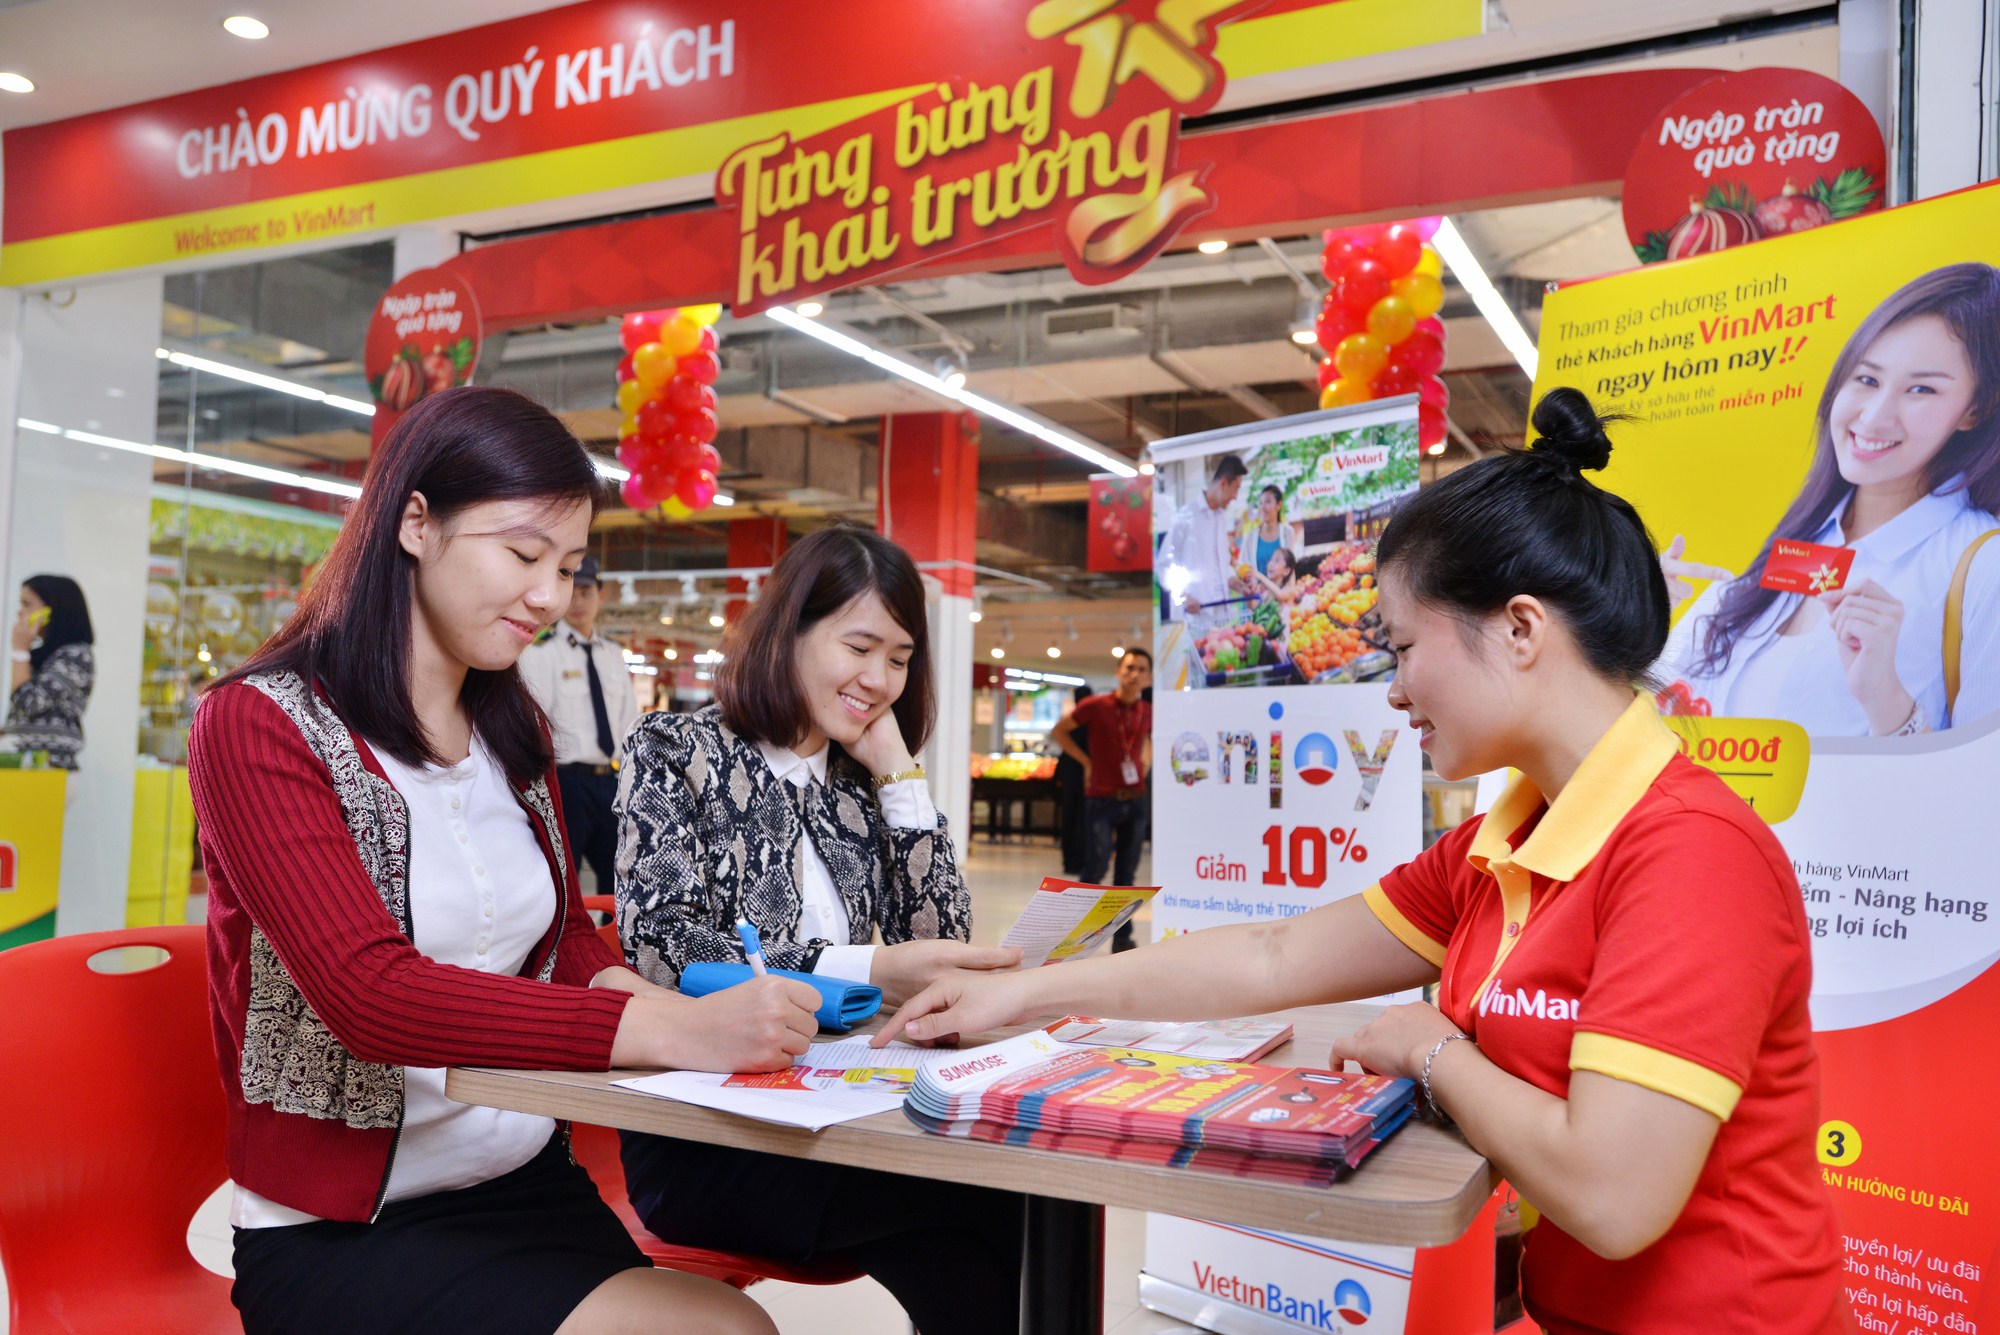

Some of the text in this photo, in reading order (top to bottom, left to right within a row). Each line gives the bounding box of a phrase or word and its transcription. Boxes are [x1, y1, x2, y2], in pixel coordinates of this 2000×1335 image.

[177, 20, 735, 179] CHÀO MỪNG QUÝ KHÁCH
[1659, 98, 1824, 150] Ngập tràn
[721, 65, 1053, 232] Tưng bừng
[1694, 129, 1839, 177] quà tặng
[176, 202, 375, 252] Welcome to VinMart
[739, 108, 1170, 304] khai trương
[1559, 273, 1788, 342] Tham gia chương trình
[1556, 294, 1837, 370] thẻ Khách hàng VinMart
[1597, 370, 1654, 398] ngay
[1663, 357, 1719, 383] hôm
[1719, 391, 1765, 411] miễn
[1772, 382, 1803, 407] phí
[1335, 451, 1383, 471] VinMart
[1171, 701, 1399, 811] enjoy
[1196, 824, 1368, 889] Giảm 10%
[1806, 860, 1842, 882] hàng
[1847, 864, 1910, 882] VinMart
[1163, 893, 1178, 907] khi
[1180, 899, 1201, 910] mua
[1800, 881, 1831, 903] ểm
[1854, 887, 1916, 916] Nâng
[1924, 891, 1989, 923] hạng
[1836, 913, 1864, 939] lợi
[1873, 918, 1907, 940] ích
[1478, 978, 1580, 1022] VinMar
[938, 1055, 1008, 1082] SUNHOUSE
[1826, 1130, 1845, 1158] 3
[1847, 1175, 1907, 1202] HƯỞNG
[1911, 1189, 1935, 1208] ƯU
[1938, 1196, 1969, 1216] ĐÃI
[1875, 1265, 1922, 1291] thành
[1927, 1280, 1969, 1303] viên.
[1927, 1256, 1949, 1274] ưu
[1953, 1260, 1981, 1281] đãi
[1192, 1260, 1333, 1332] VietinBank
[1882, 1292, 1902, 1315] lợi
[1906, 1299, 1939, 1327] hấp
[1943, 1311, 1977, 1335] dẫn
